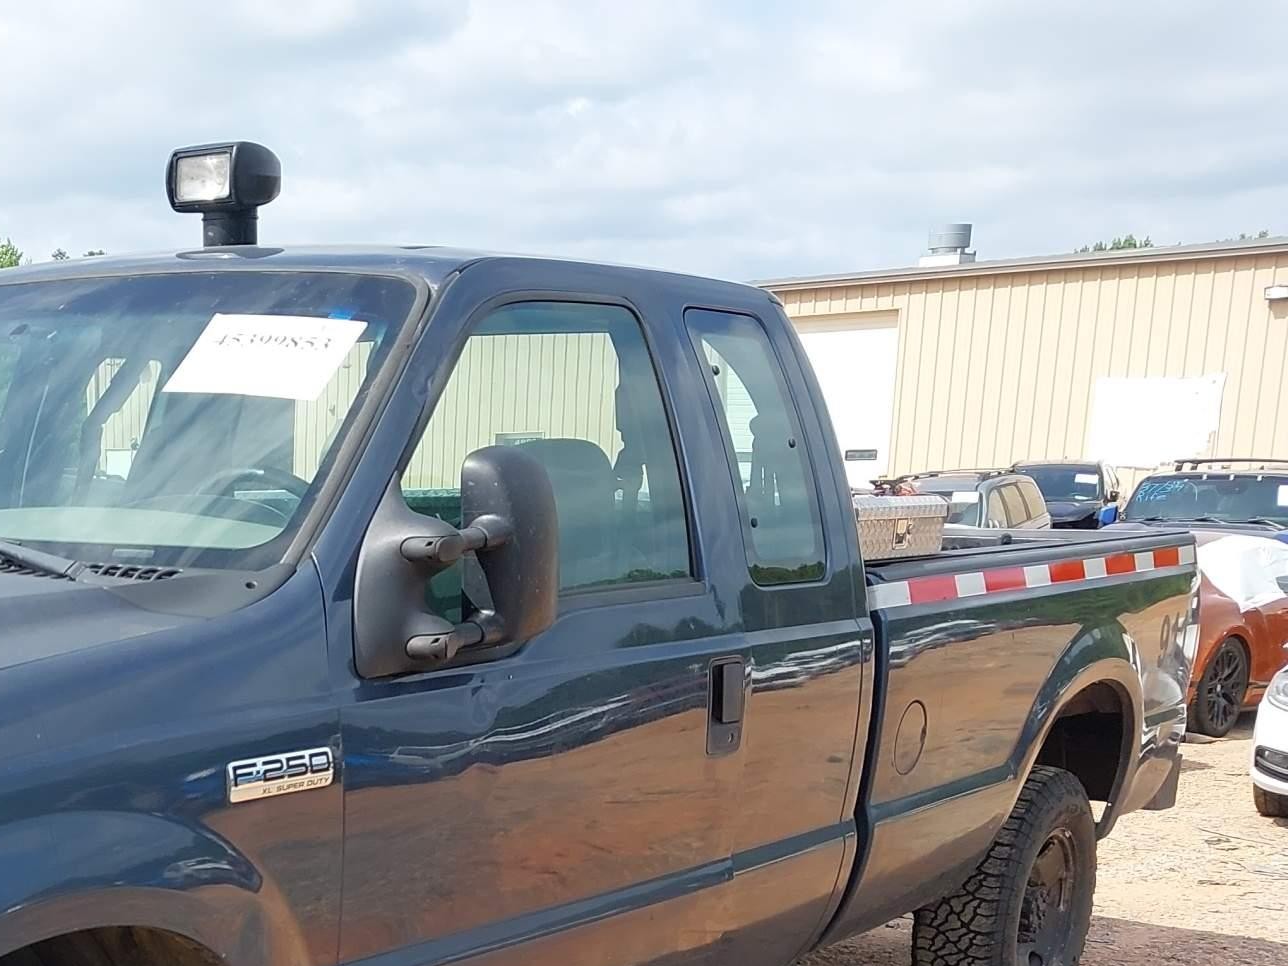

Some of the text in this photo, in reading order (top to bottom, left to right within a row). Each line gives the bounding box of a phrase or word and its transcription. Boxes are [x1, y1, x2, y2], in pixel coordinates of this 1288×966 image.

[232, 751, 331, 787] F-250
[262, 777, 330, 795] XL SUPER DUTY
